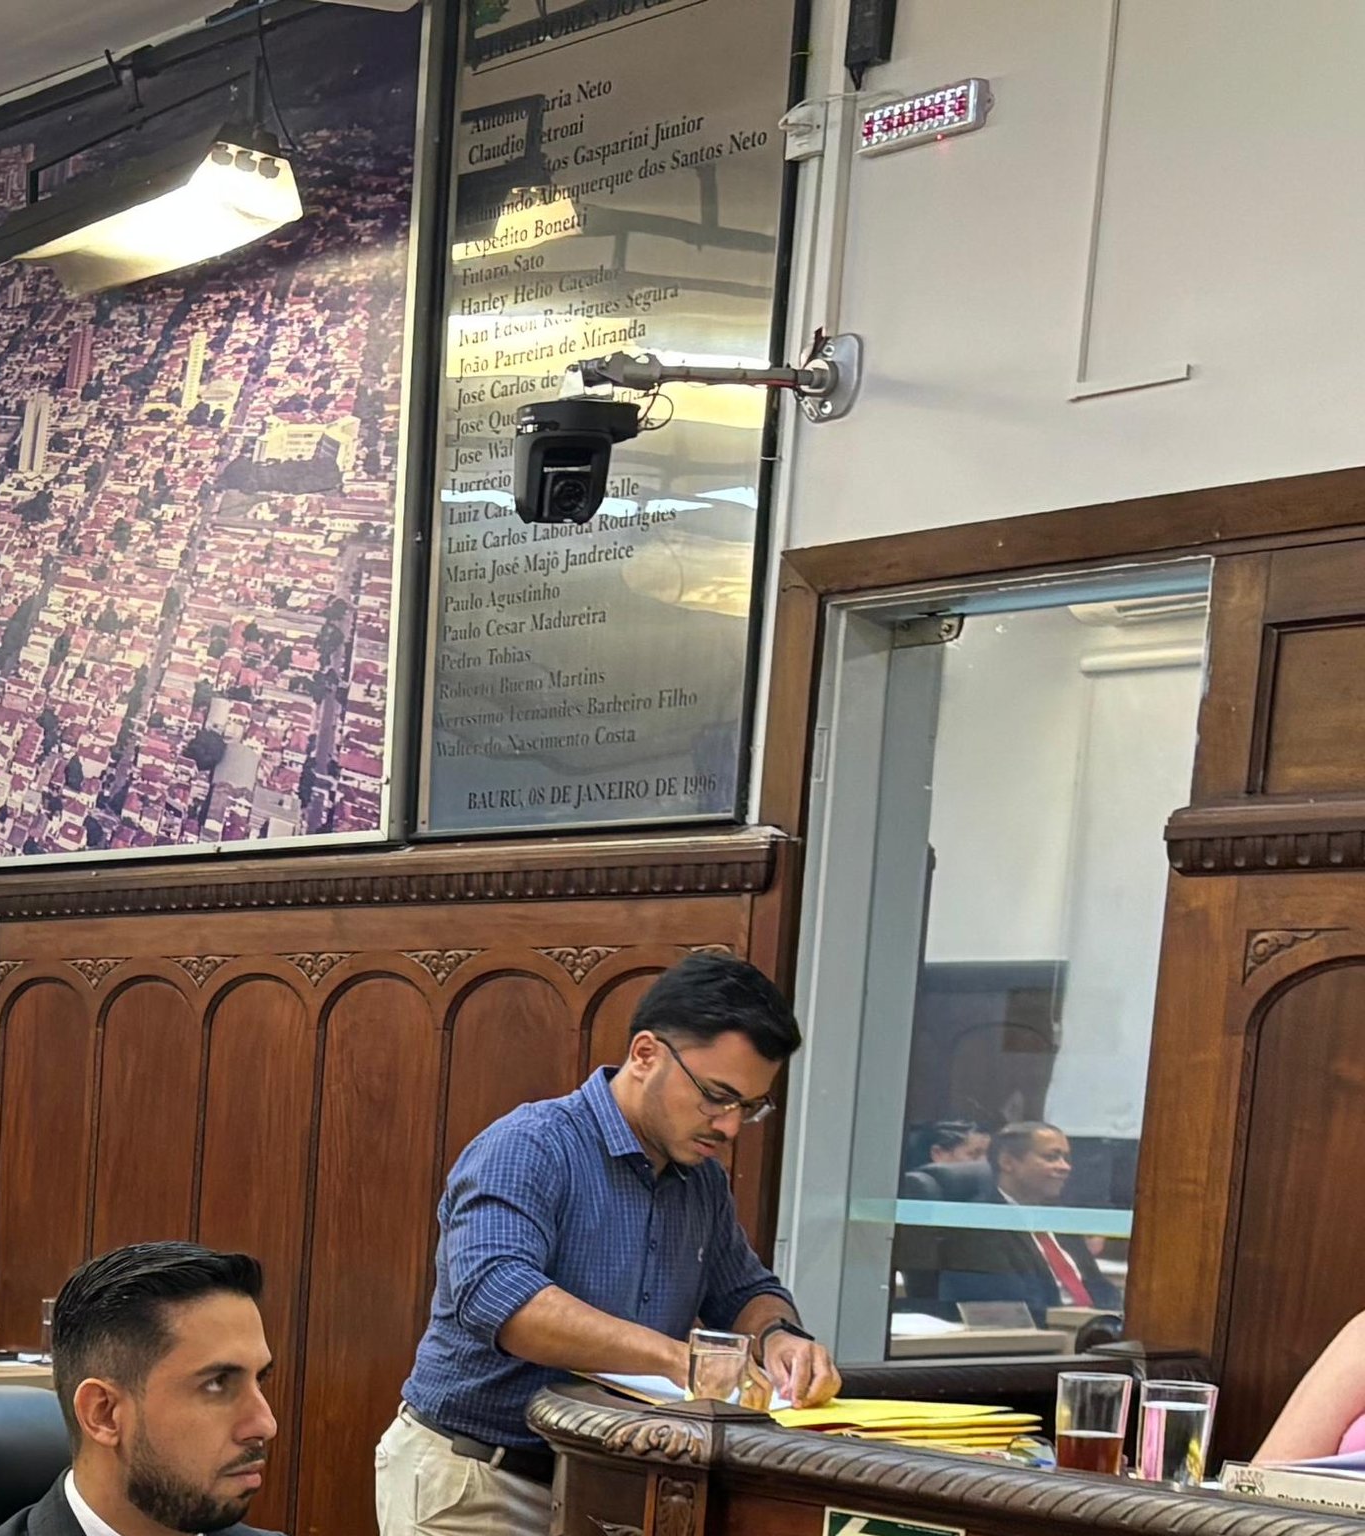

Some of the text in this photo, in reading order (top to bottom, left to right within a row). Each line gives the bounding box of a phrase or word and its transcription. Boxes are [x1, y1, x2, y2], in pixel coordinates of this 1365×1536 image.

[542, 89, 572, 112] aria
[577, 80, 612, 103] Neto
[468, 114, 584, 165] Claudio etroni
[574, 127, 649, 166] Gasparini
[651, 115, 704, 150] Júnior
[536, 169, 633, 207] Albuquerque
[638, 158, 666, 179] dos
[670, 143, 723, 170] Santos
[729, 131, 767, 155] Neto
[534, 207, 587, 238] Bonetti
[513, 254, 544, 273] Sato
[459, 329, 488, 347] Ivan
[543, 300, 619, 327] Rodrigues
[626, 286, 679, 310] Segura
[460, 291, 508, 317] Harley
[456, 320, 646, 384] João Parreira de Miranda
[456, 370, 558, 412] José Carlos de
[488, 440, 514, 459] Wal
[449, 499, 517, 525] Luiz Car
[447, 535, 478, 555] Luiz
[482, 528, 527, 549] Carlos
[598, 505, 677, 532] Rodrigues
[446, 562, 486, 584] Maria
[488, 558, 519, 584] José
[562, 541, 635, 573] Jandreice
[444, 583, 560, 613] Paulo Agustinho
[443, 607, 607, 642] Paulo Cesar Madureira
[441, 646, 531, 671] Pedro Tobias
[439, 667, 605, 699] Roberto Bueno Martins
[658, 688, 697, 709] Filho
[508, 731, 589, 752] Nascimento
[595, 726, 636, 745] Costa
[468, 774, 716, 810] BAURU, 08 DE JANEIRO DE 1996
